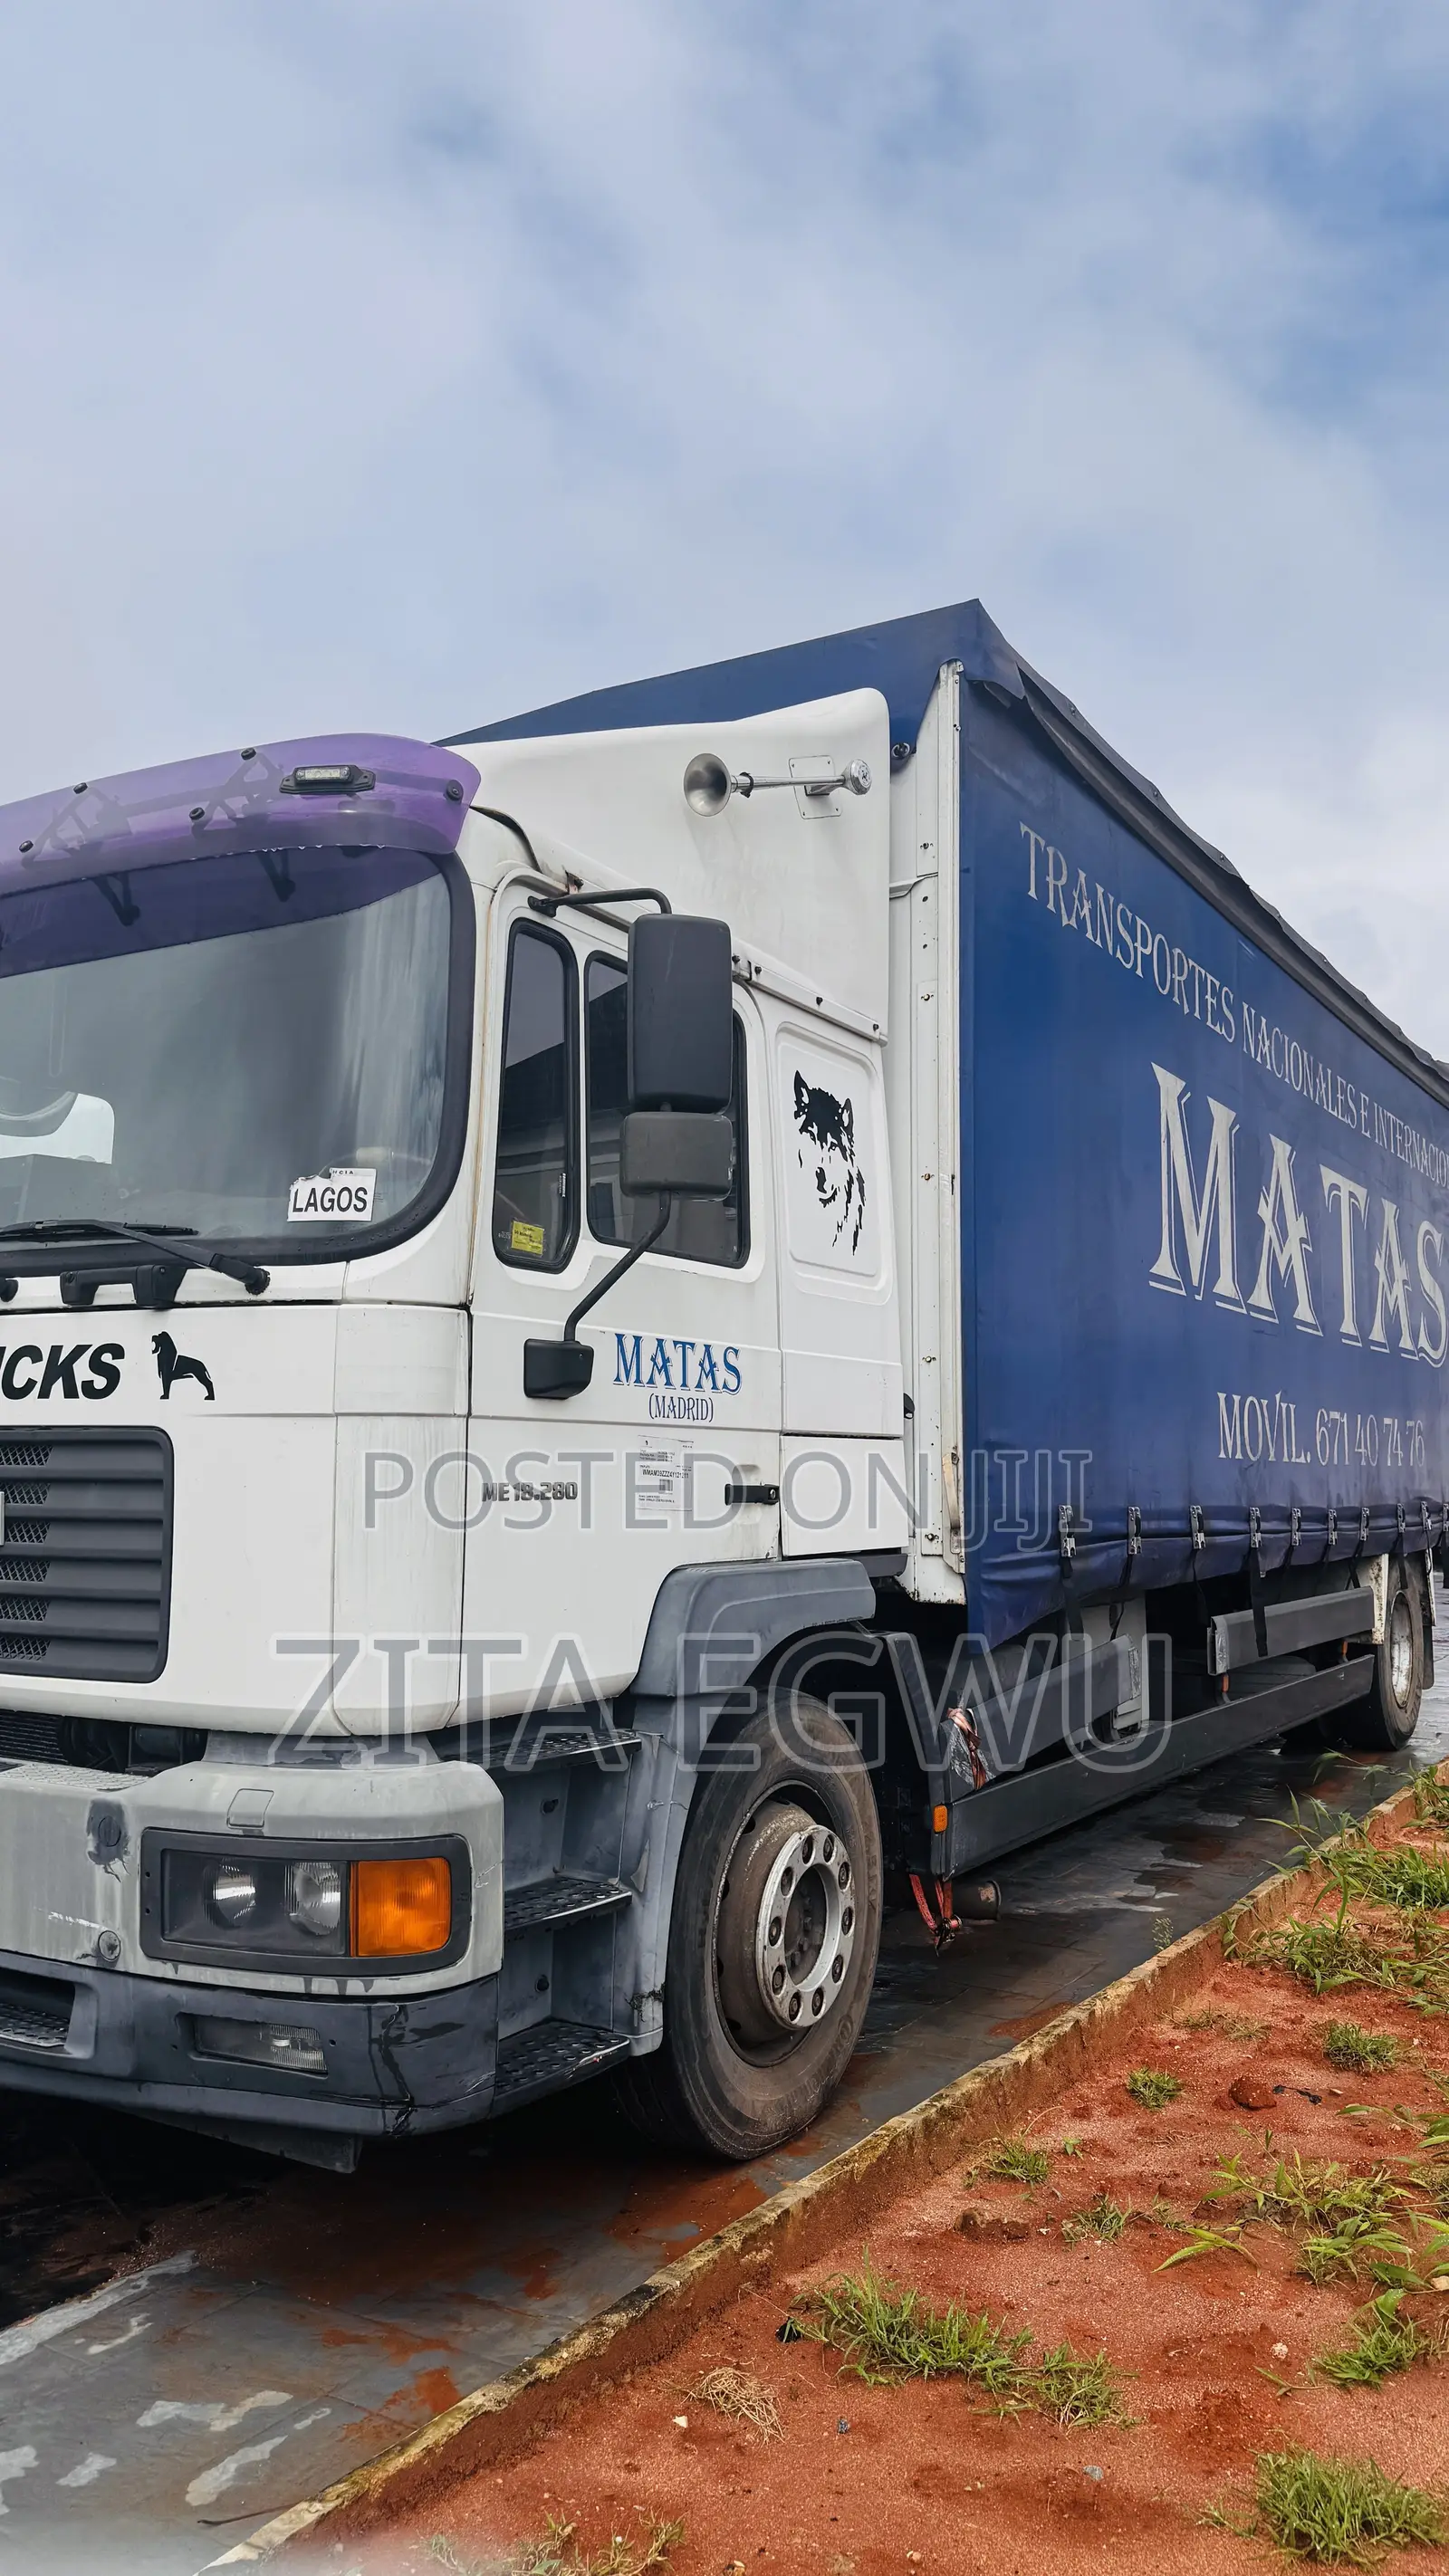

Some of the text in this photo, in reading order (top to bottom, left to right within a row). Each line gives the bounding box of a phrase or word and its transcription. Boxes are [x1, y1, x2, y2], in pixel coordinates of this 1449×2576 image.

[1020, 820, 1235, 1042] TRANSPORTES
[1242, 1001, 1358, 1129] NACIONALES
[1359, 1091, 1371, 1139] E
[293, 1186, 368, 1213] LAGOS
[1148, 1061, 1448, 1368] MATAS
[613, 1333, 743, 1395] MATAS
[648, 1393, 714, 1423] (MADRID)
[1316, 1408, 1349, 1466] 671
[1355, 1413, 1378, 1466] 40
[1383, 1417, 1403, 1466] 74
[1406, 1420, 1425, 1467] 76
[482, 1481, 578, 1502] ME 18.280
